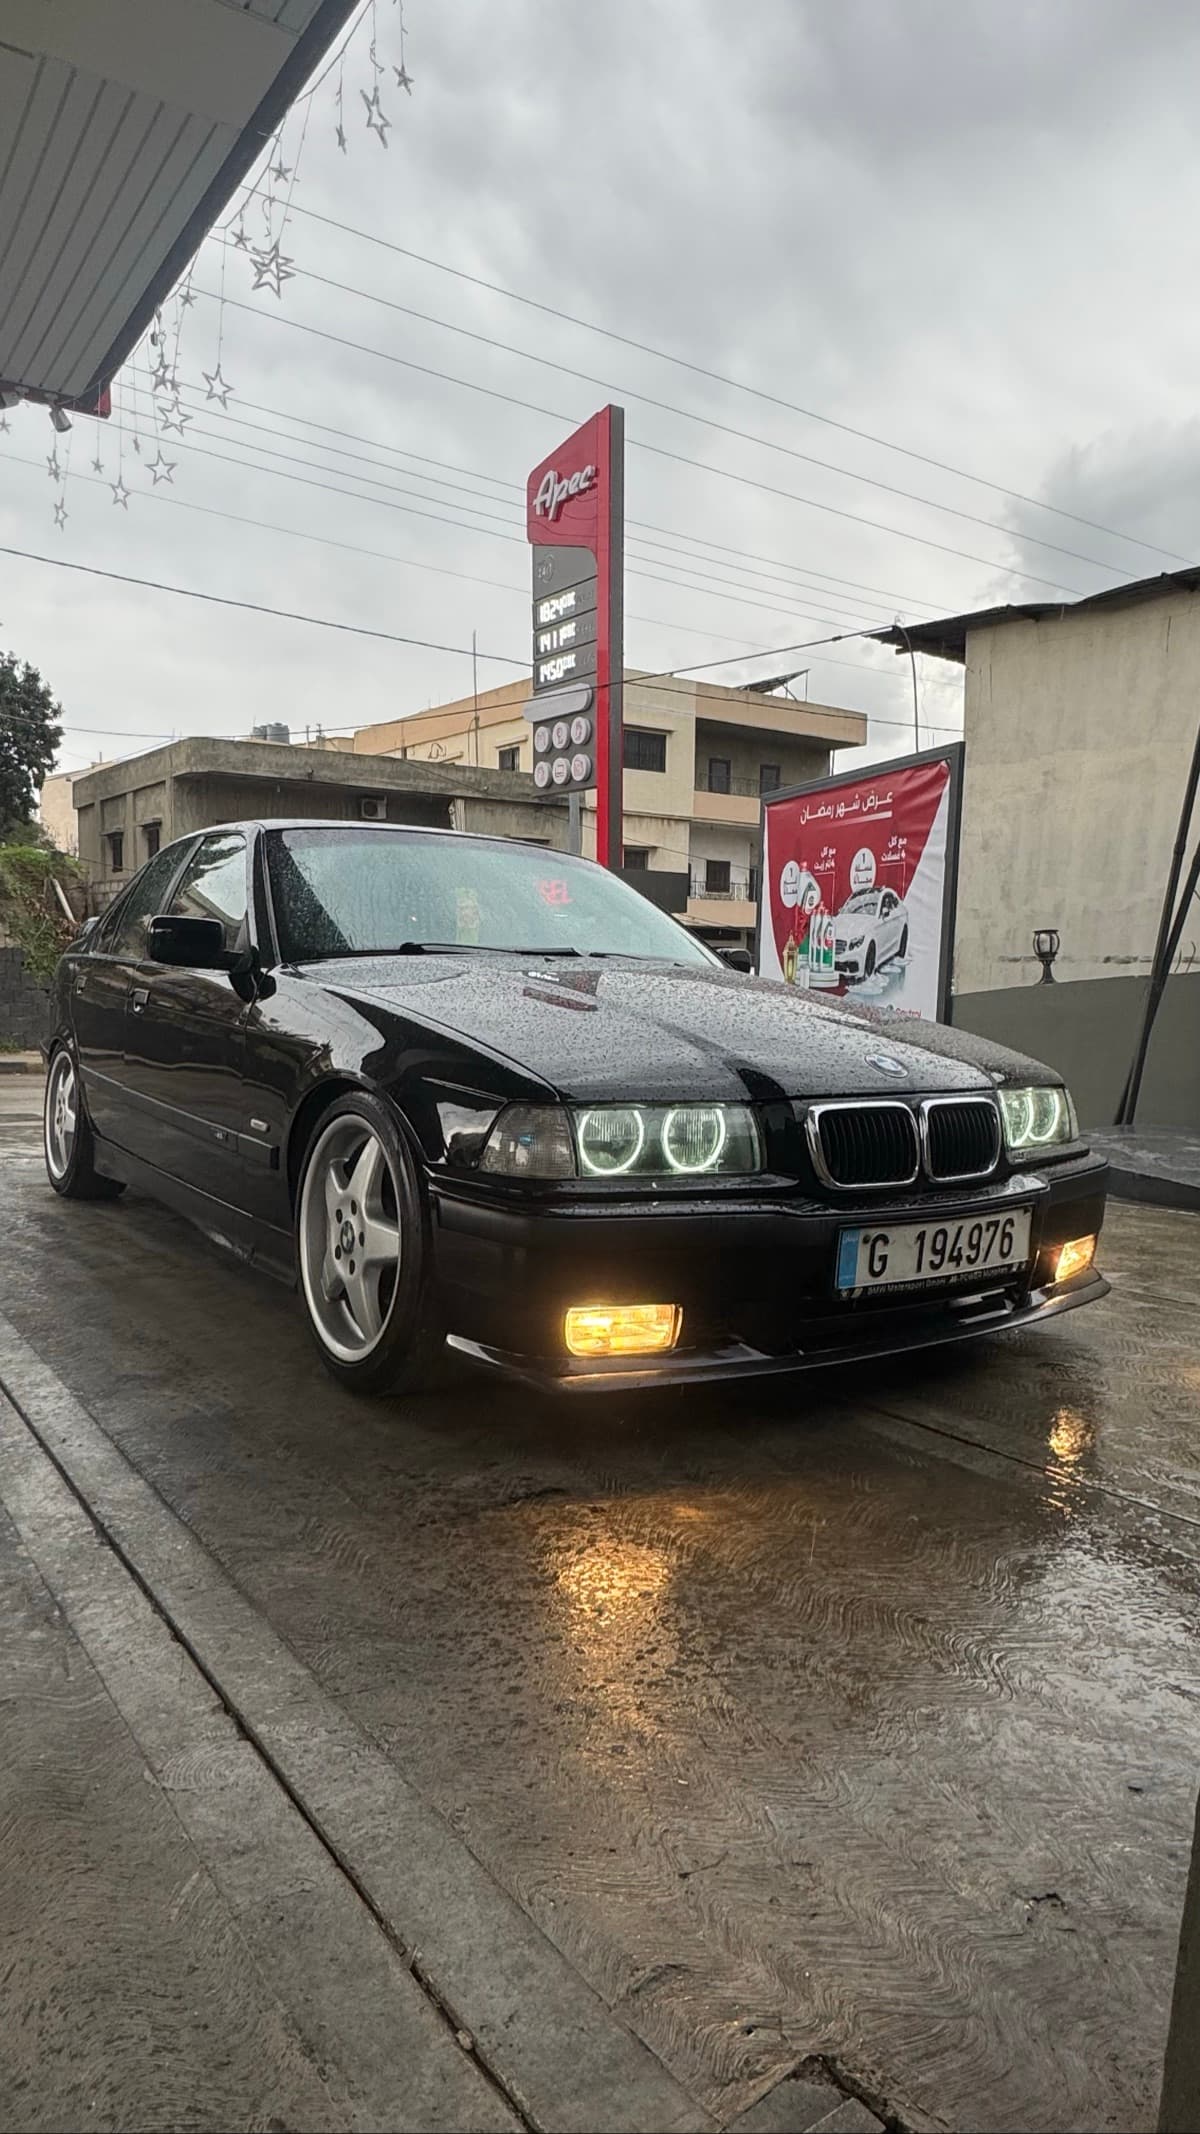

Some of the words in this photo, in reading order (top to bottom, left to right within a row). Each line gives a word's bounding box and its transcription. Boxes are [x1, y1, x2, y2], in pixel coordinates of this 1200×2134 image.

[532, 465, 597, 521] Apec
[800, 801, 834, 825] رمضان
[835, 793, 860, 818] شهر
[862, 790, 893, 812] عرض
[868, 1233, 890, 1278] G
[914, 1217, 1016, 1274] 194976
